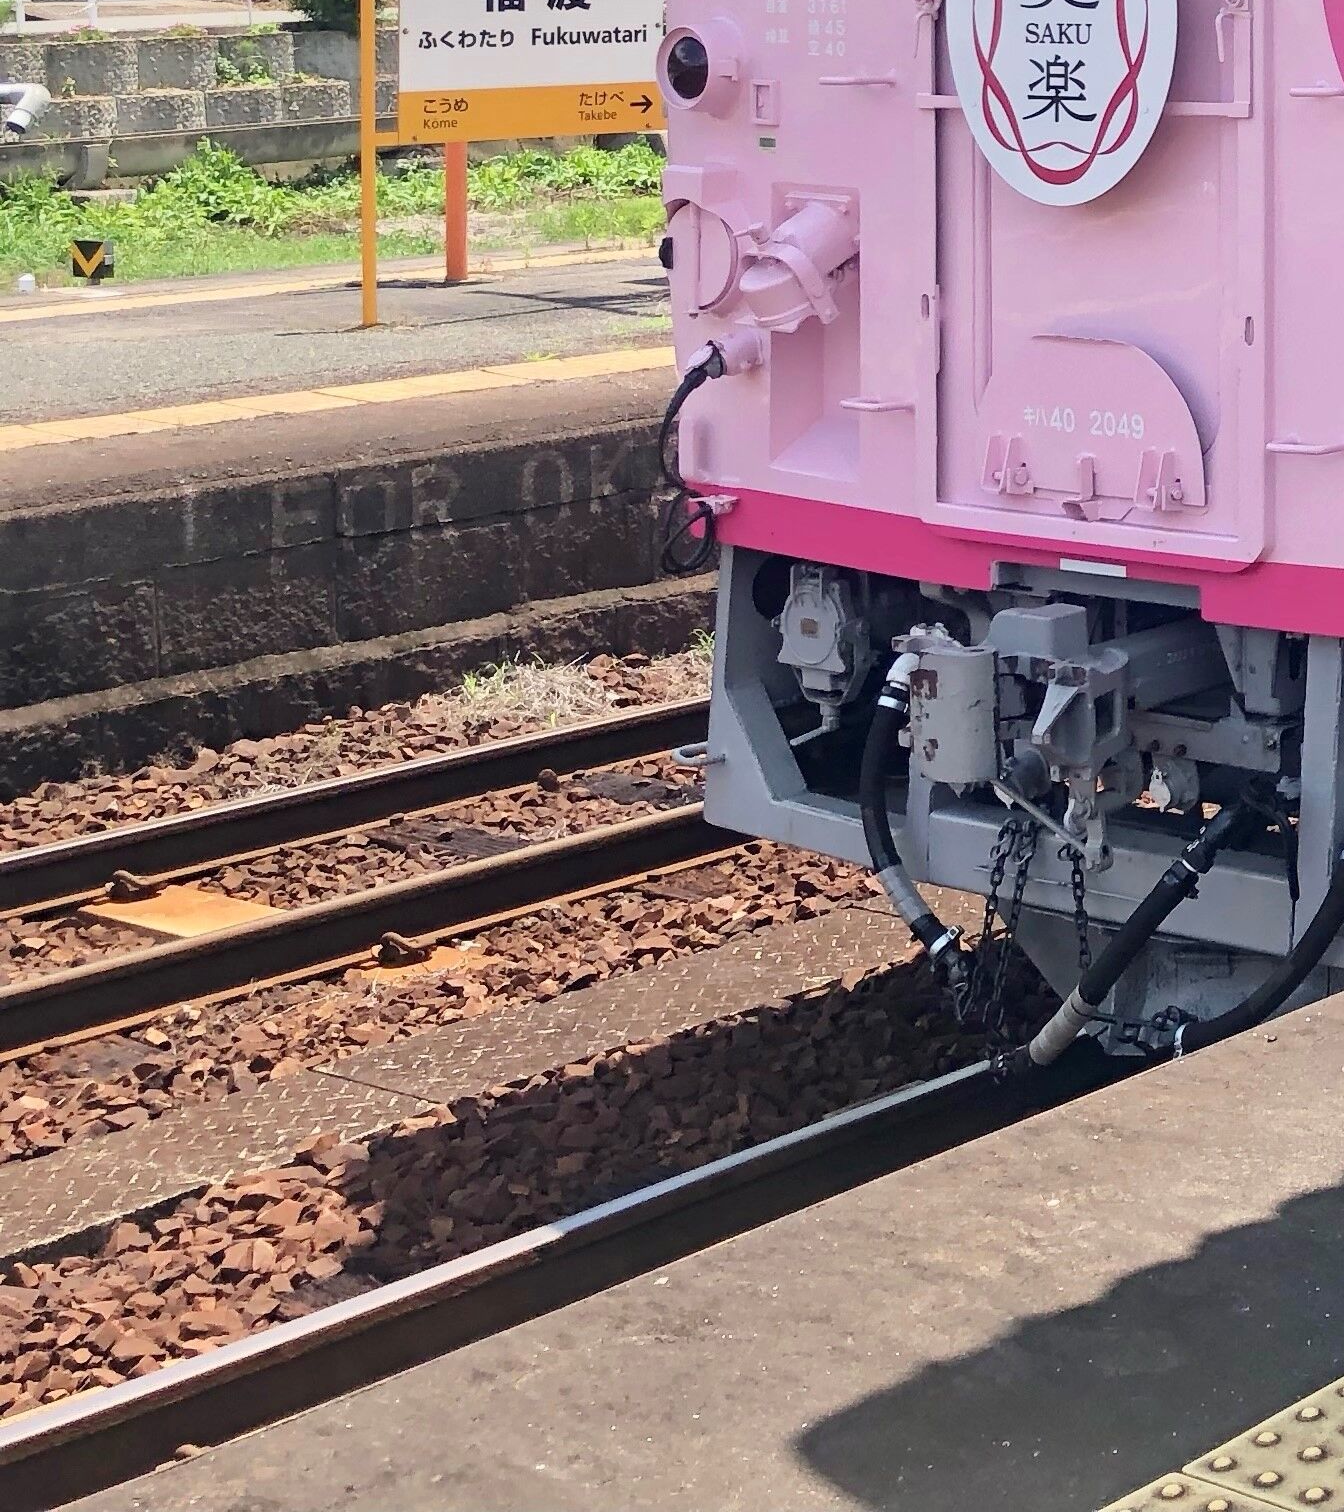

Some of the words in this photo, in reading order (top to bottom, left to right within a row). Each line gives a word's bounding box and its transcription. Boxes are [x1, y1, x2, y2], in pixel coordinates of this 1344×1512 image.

[418, 29, 515, 49] ふくわたり
[531, 25, 648, 46] Fukuwatari
[1025, 23, 1092, 45] SAKU
[579, 91, 625, 107] たけべ
[1022, 54, 1098, 123] 楽
[423, 98, 469, 114] こうめ
[578, 109, 617, 121] Takebe
[1023, 407, 1076, 433] キハ40
[1089, 410, 1145, 440] 2049
